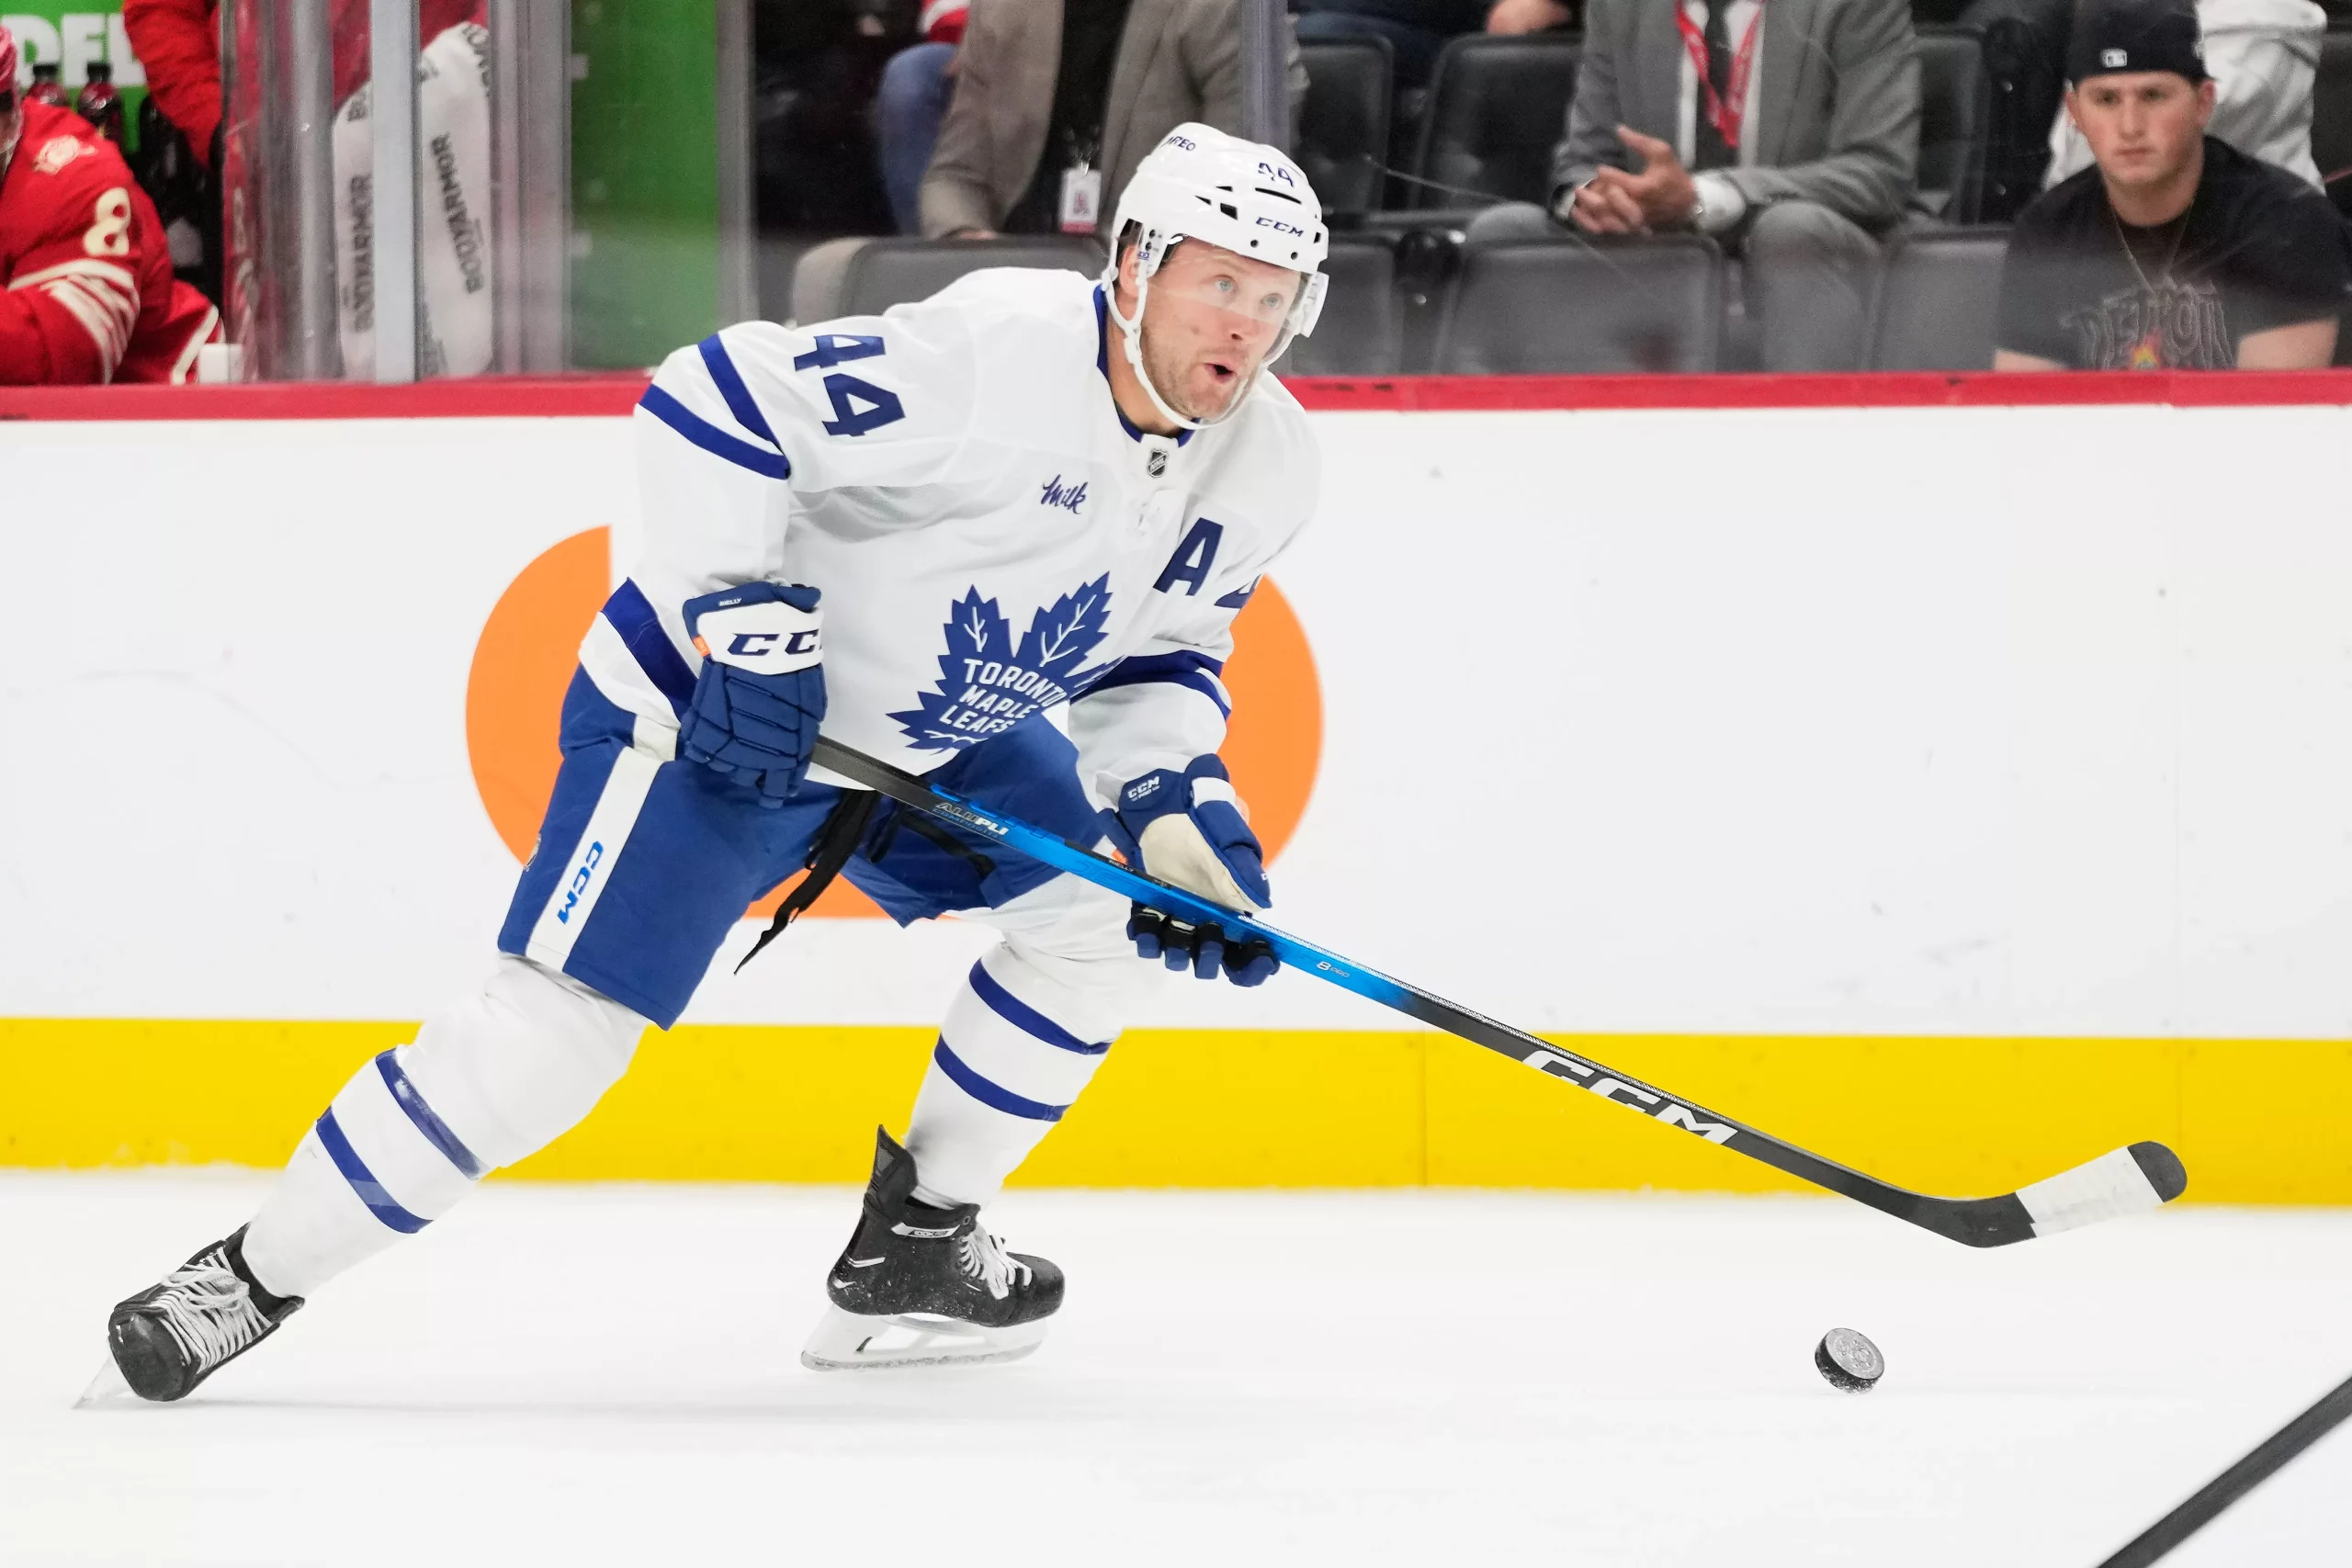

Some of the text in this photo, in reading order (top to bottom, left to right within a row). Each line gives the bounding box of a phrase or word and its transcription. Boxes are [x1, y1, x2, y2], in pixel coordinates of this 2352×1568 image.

[1255, 217, 1304, 237] CCM
[794, 333, 906, 437] 44
[1041, 474, 1089, 514] Milk
[1153, 517, 1224, 596] A
[727, 628, 822, 656] CC
[959, 684, 1039, 719] MAPLE
[964, 658, 1068, 707] TORONTO
[939, 705, 1016, 733] LEAFS
[1128, 775, 1159, 798] CCM
[557, 840, 604, 925] CCM
[1522, 1050, 1738, 1145] CCM
